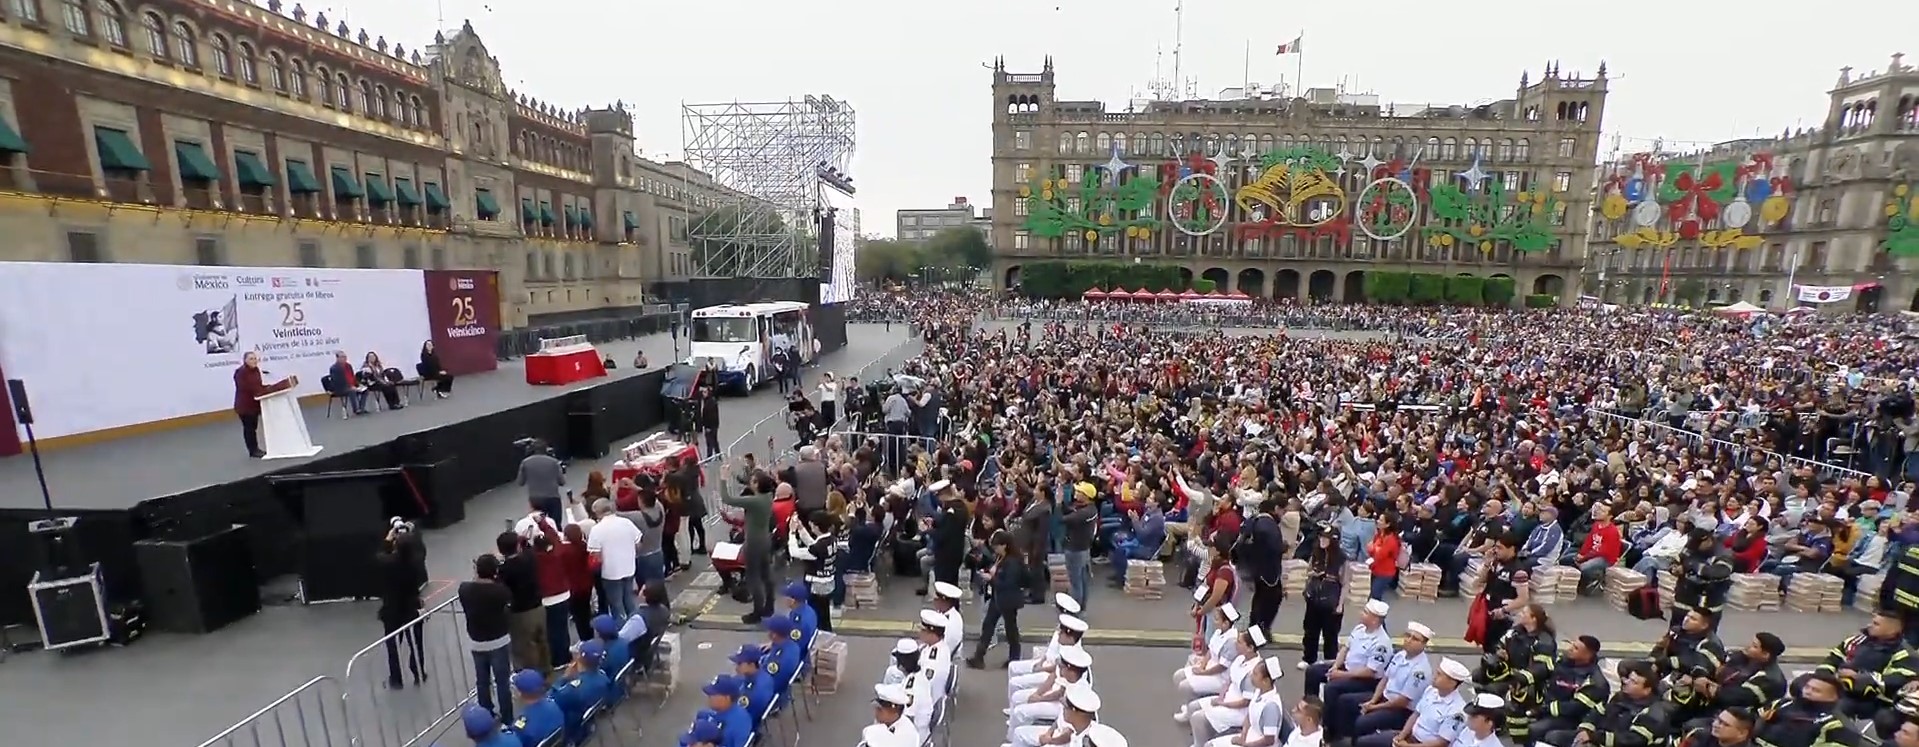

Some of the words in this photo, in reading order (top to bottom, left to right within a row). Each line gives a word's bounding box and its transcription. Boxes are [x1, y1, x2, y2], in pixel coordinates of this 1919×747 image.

[195, 279, 229, 290] México
[236, 275, 264, 284] Cultura
[244, 291, 274, 302] Entrega
[276, 291, 304, 302] gratuita
[305, 290, 315, 299] de
[315, 290, 335, 299] libros
[278, 302, 304, 327] 25
[452, 296, 475, 326] 25
[272, 327, 322, 339] Veinticinco
[446, 325, 486, 338] Veinticinco
[254, 344, 261, 352] A
[262, 341, 290, 352] jóvenes
[291, 340, 300, 348] de
